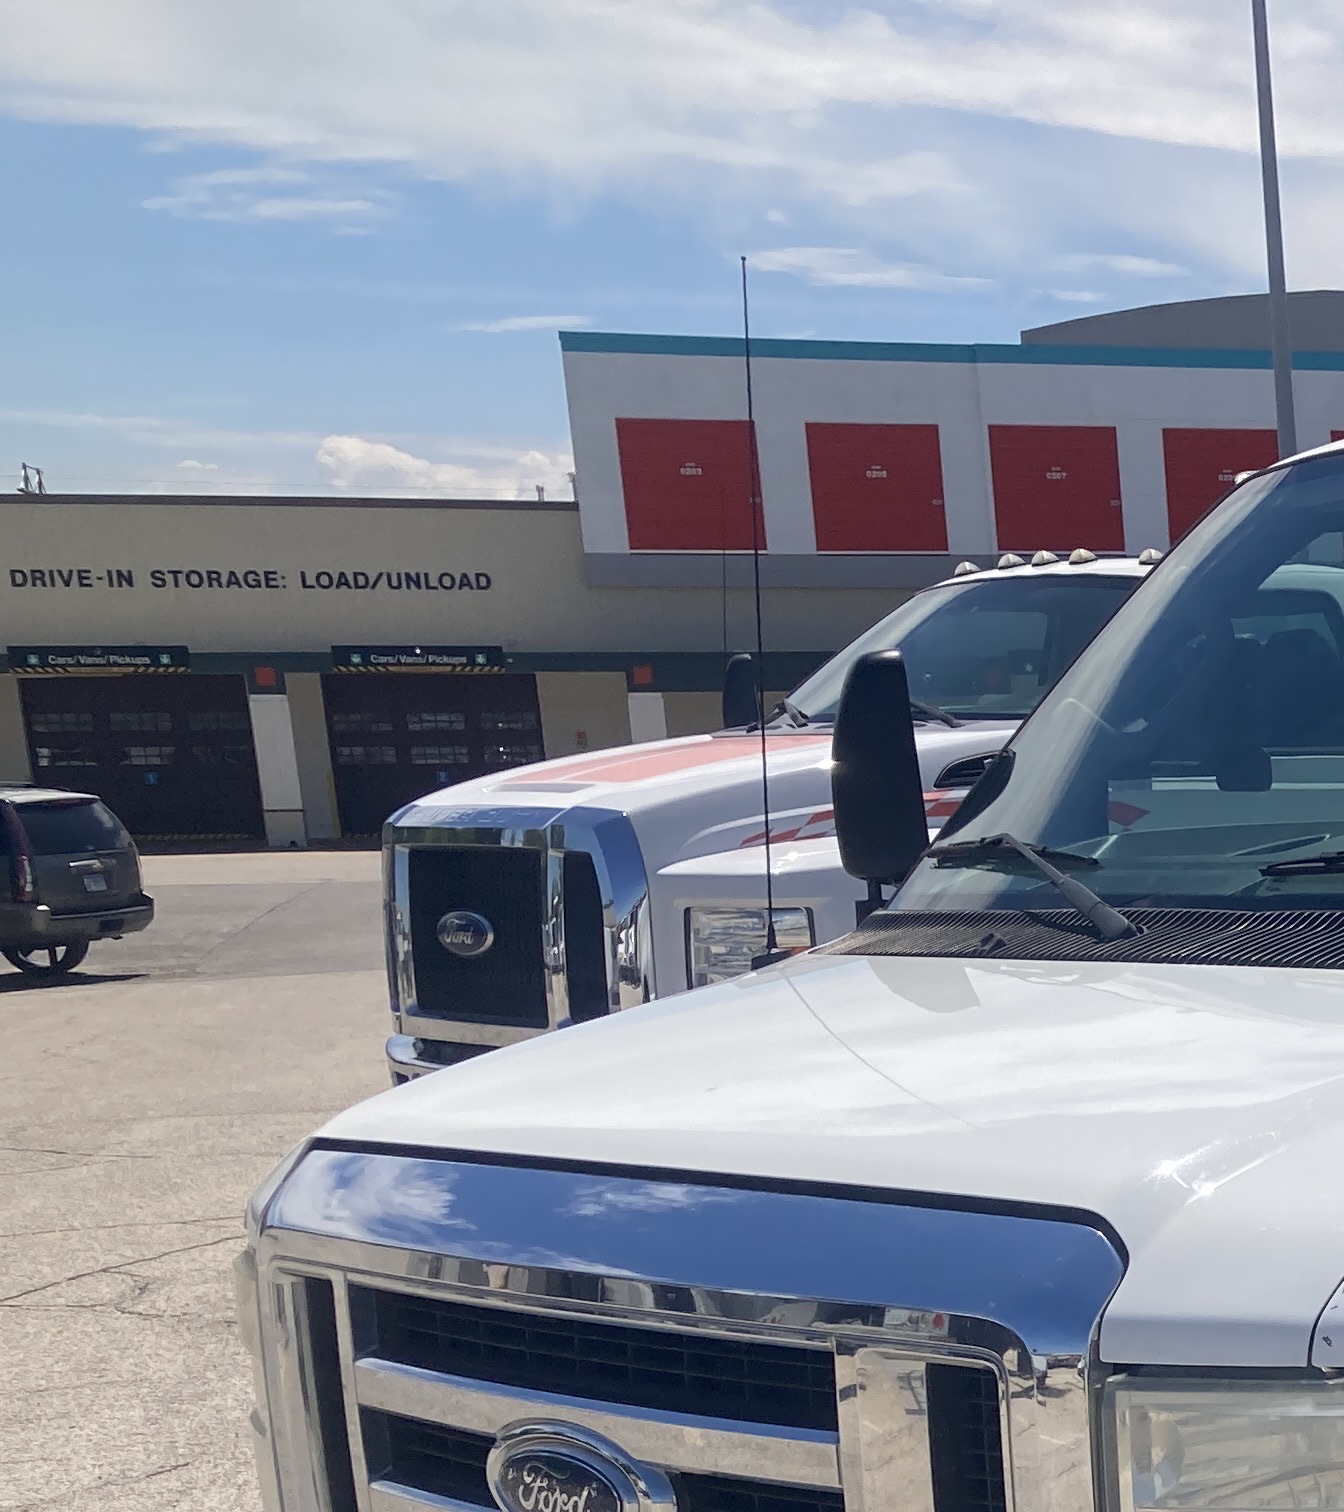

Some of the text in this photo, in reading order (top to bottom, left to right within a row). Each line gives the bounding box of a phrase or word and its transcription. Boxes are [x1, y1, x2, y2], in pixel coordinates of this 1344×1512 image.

[9, 568, 492, 591] DRIVE-IN STORAGE: LOAD/UNLOAD
